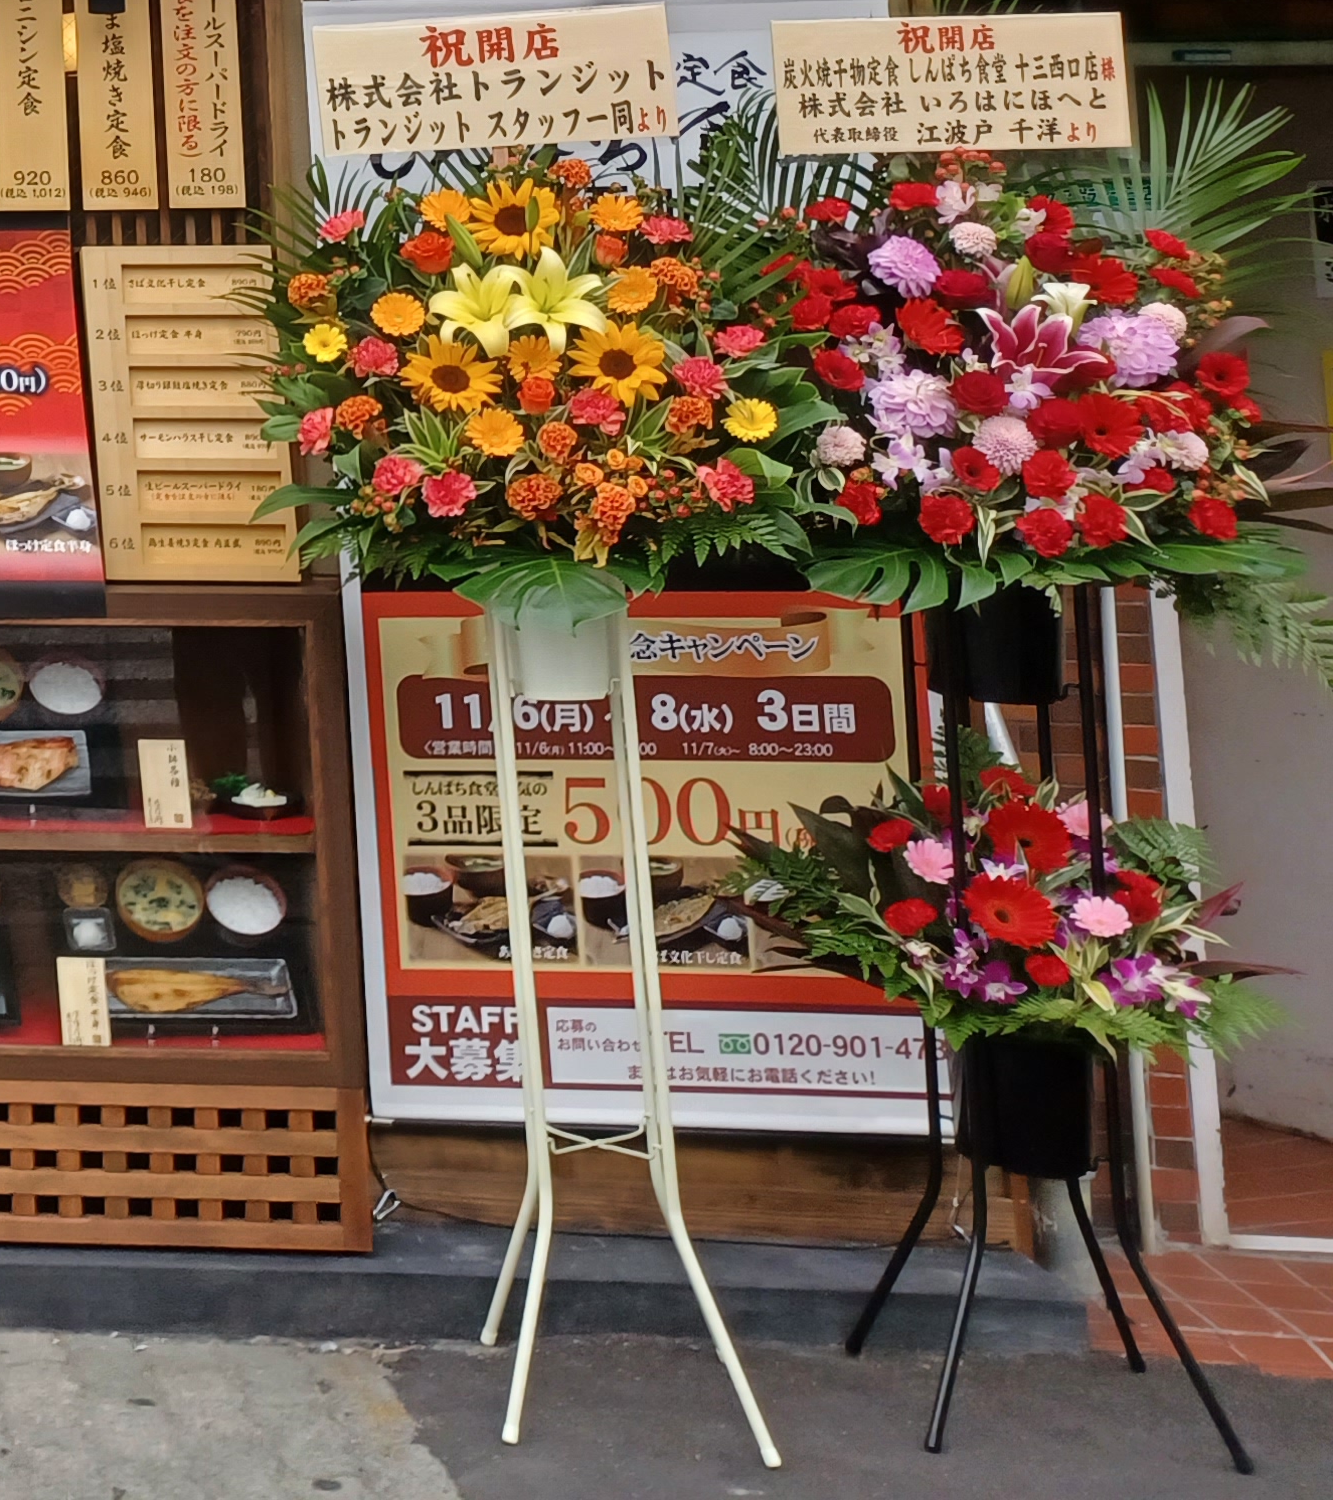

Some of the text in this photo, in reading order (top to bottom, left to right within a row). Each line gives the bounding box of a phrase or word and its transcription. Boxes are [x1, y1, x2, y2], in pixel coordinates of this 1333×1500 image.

[421, 24, 559, 68] 祝開店
[897, 22, 995, 53] 祝開店
[783, 51, 1116, 89] 炭火焼干物定食 しんぱち食堂 十三西口店様
[102, 13, 131, 160] ま塩焼き定食
[326, 61, 666, 111] 株式会社トランジット
[799, 87, 1107, 118] 株式会社 いろはにほへと
[331, 99, 667, 151] トランジット スタッフ一同より
[814, 128, 899, 143] 代表取締役
[917, 120, 993, 145] 江波戸
[13, 171, 51, 185] 920
[101, 170, 139, 184] 860
[189, 168, 225, 183] 180
[128, 279, 205, 288] さば文化干し定食
[132, 330, 179, 339] ほっけ定食
[140, 433, 233, 443] サーモンハラス干し定食
[145, 482, 241, 491] 生ビールスーパードライ
[757, 689, 856, 733] 3日間
[556, 1019, 596, 1033] 応募の
[664, 1032, 704, 1053] EL
